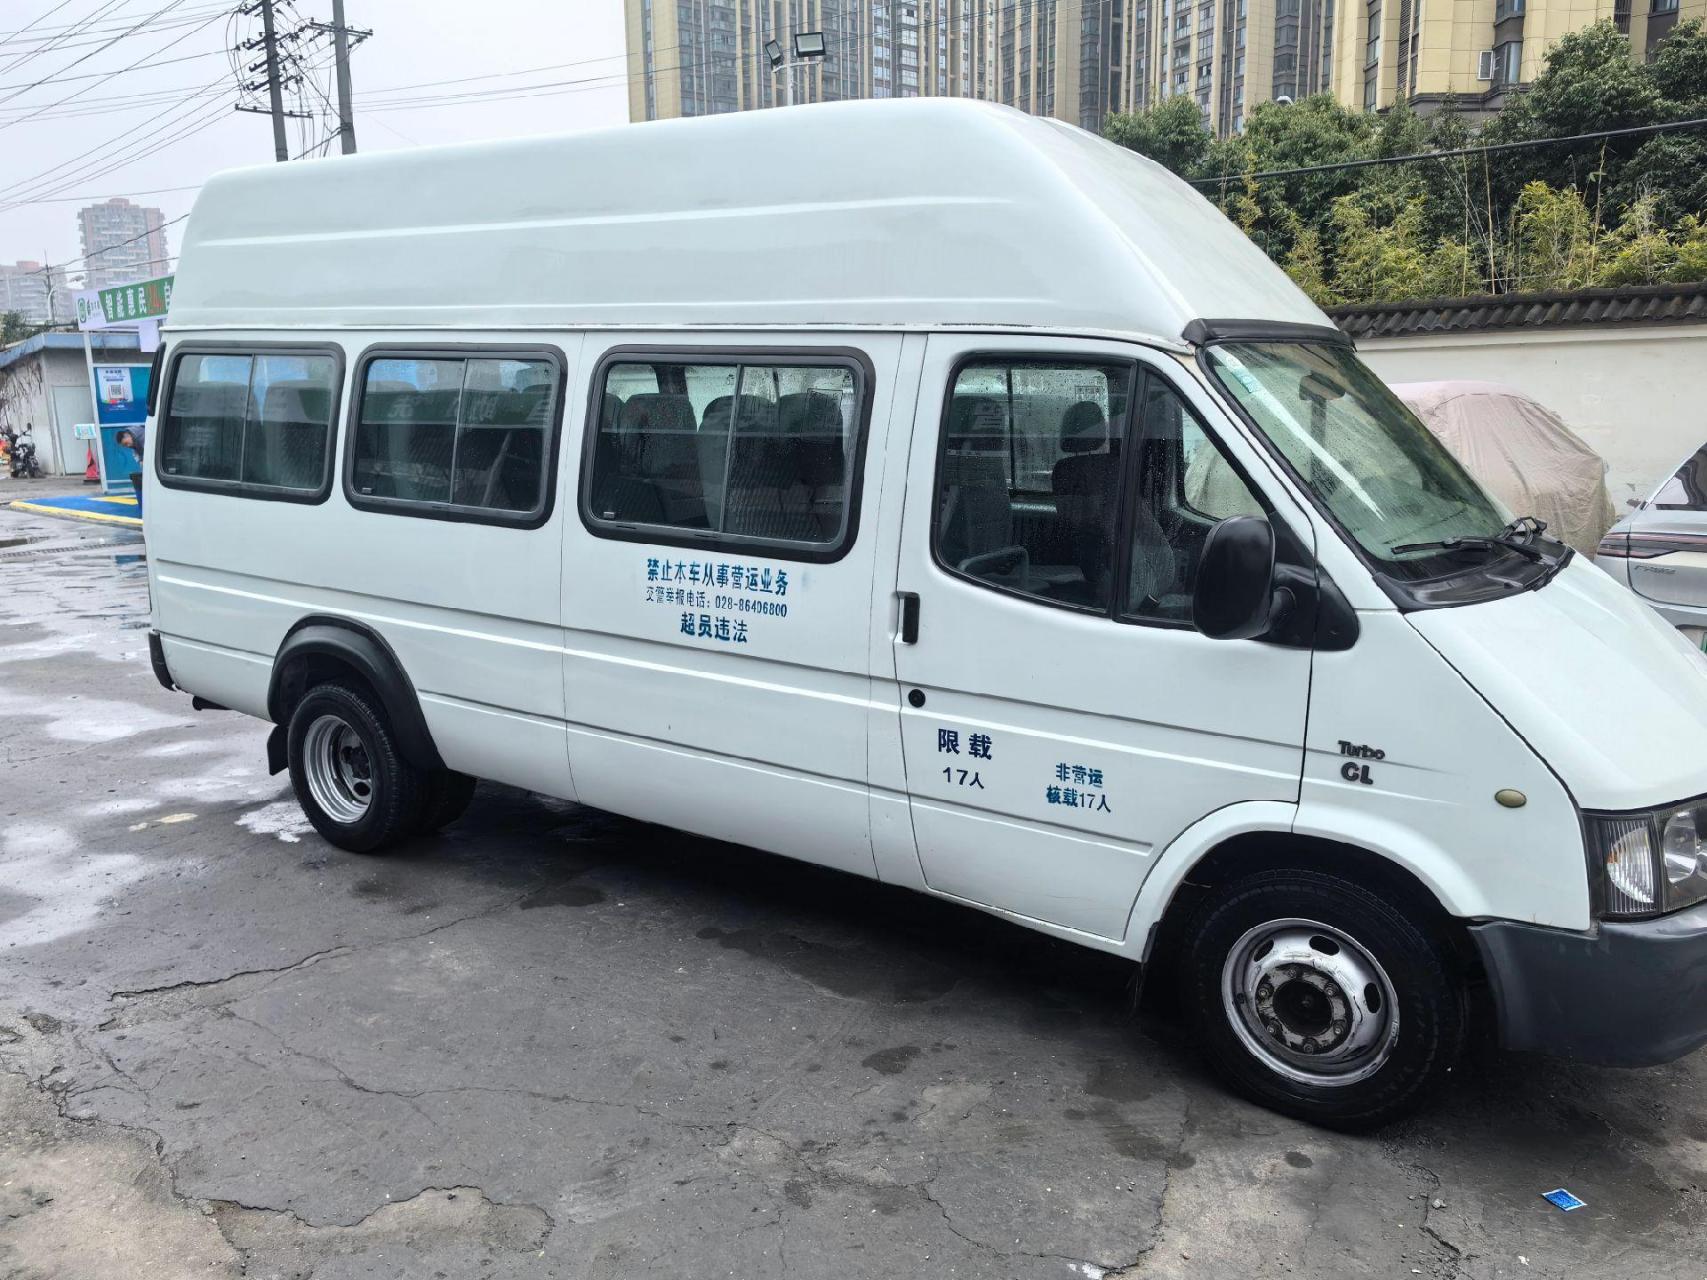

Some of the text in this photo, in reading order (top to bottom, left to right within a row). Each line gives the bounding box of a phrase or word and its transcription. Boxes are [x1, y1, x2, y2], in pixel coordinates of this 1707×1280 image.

[647, 558, 788, 596] 禁止本车从事营运业务
[680, 611, 748, 643] 超员违法
[1338, 740, 1385, 760] Turbo
[942, 766, 985, 789] 17人
[1055, 762, 1103, 788] 非营运
[1341, 762, 1373, 785] CL
[1046, 784, 1111, 813] 核载17人
